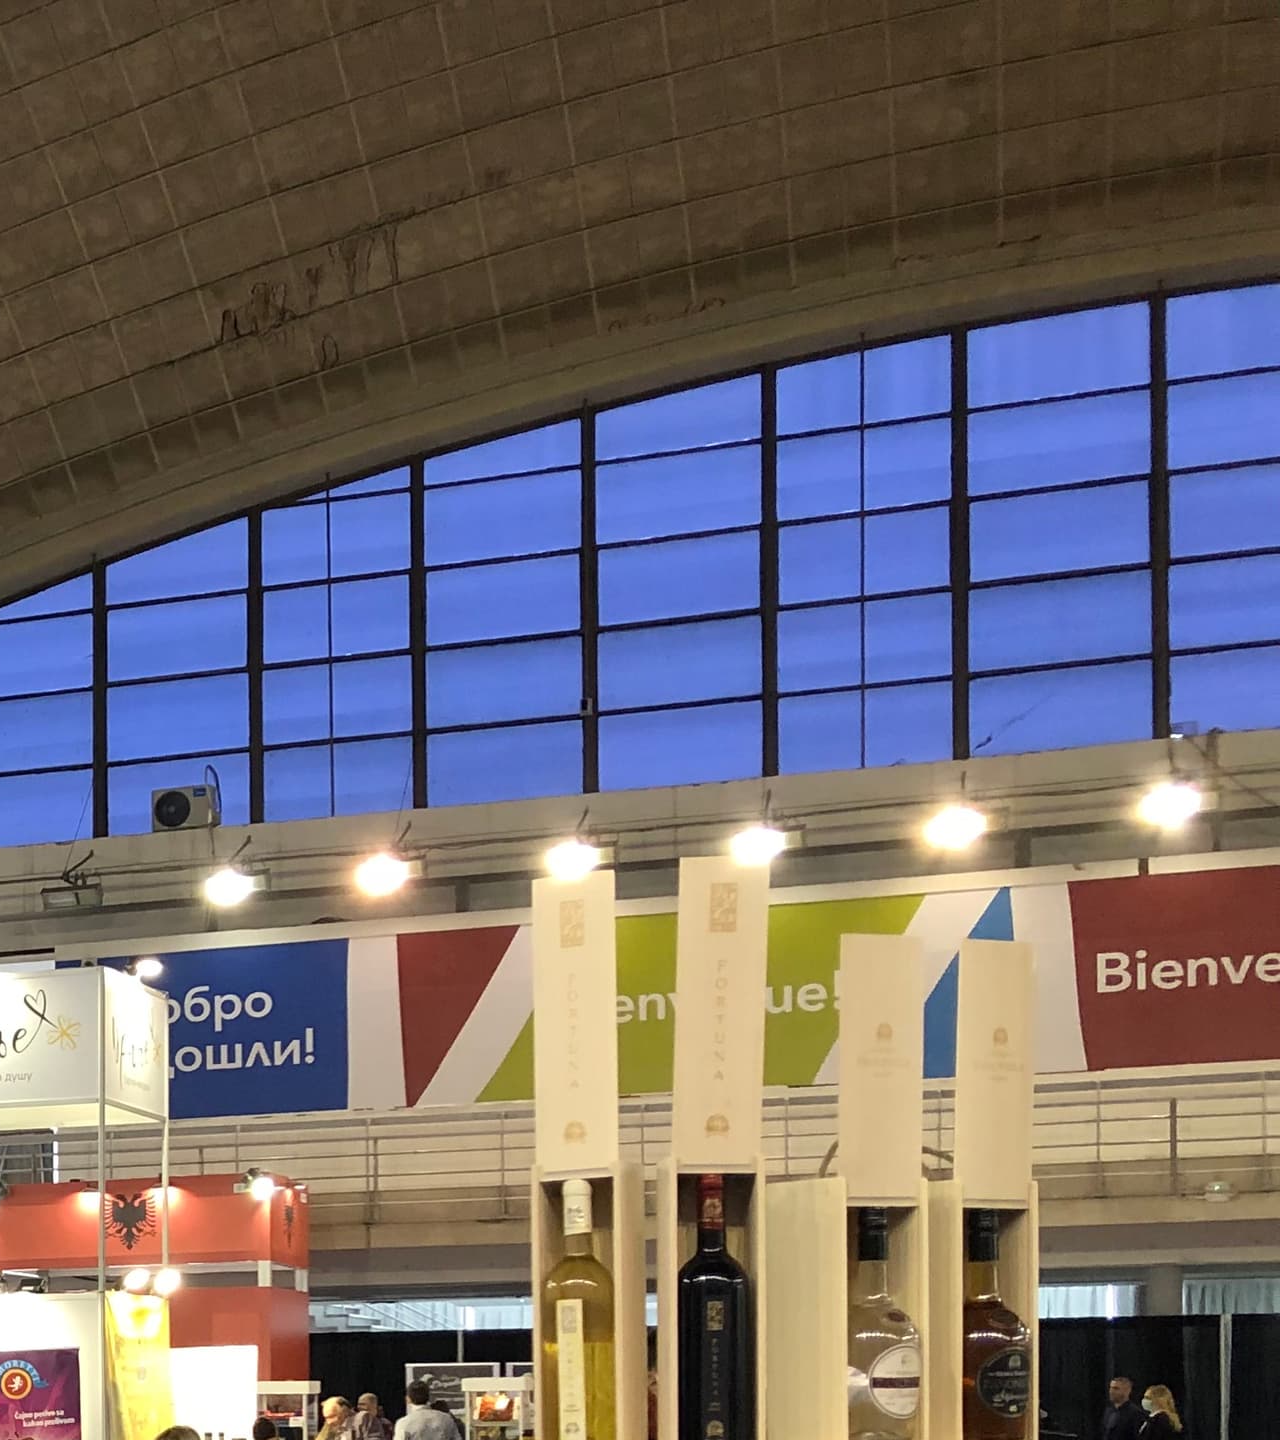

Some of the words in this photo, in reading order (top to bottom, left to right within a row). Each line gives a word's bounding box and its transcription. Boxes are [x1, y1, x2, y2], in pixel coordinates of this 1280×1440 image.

[1096, 949, 1280, 994] Bienve
[168, 985, 273, 1033] обро
[168, 1027, 317, 1080] ошли!
